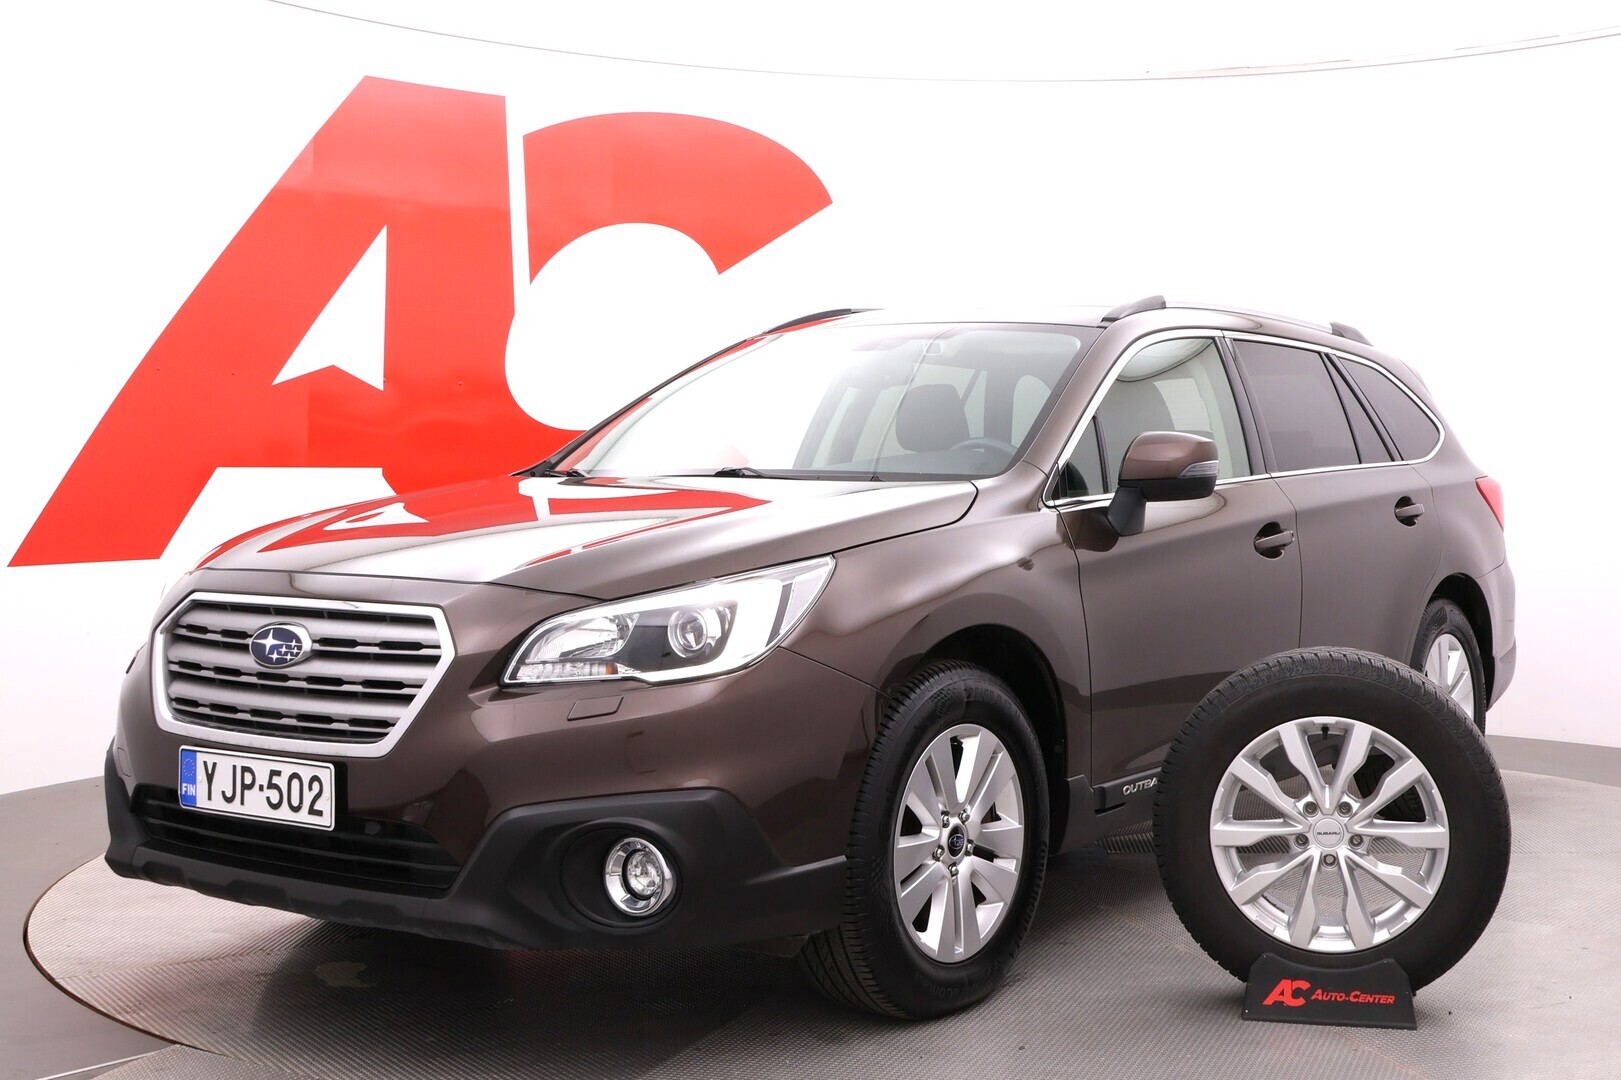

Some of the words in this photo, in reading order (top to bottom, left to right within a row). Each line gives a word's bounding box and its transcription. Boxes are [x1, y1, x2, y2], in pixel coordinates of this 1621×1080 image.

[8, 75, 833, 568] AC
[182, 782, 196, 797] FIN
[203, 760, 324, 817] YJP-502
[1262, 978, 1311, 1007] AC
